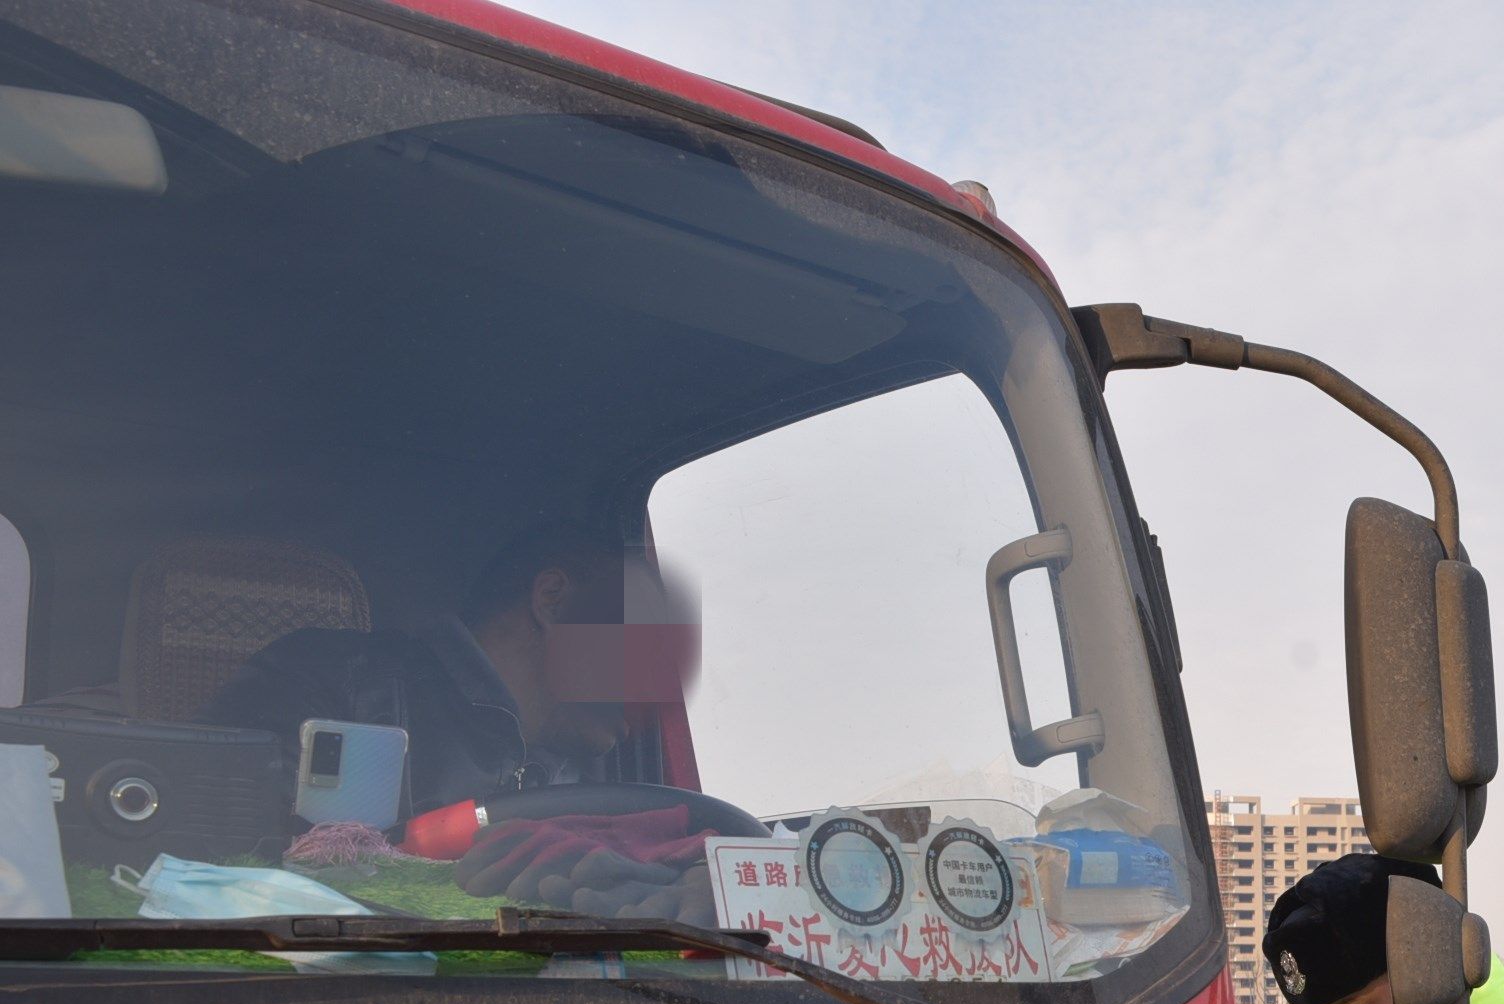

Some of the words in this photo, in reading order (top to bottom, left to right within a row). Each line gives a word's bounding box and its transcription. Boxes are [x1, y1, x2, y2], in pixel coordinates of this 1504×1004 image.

[943, 859, 993, 872] 中国卡车用户
[947, 887, 998, 900] 城市物流车型
